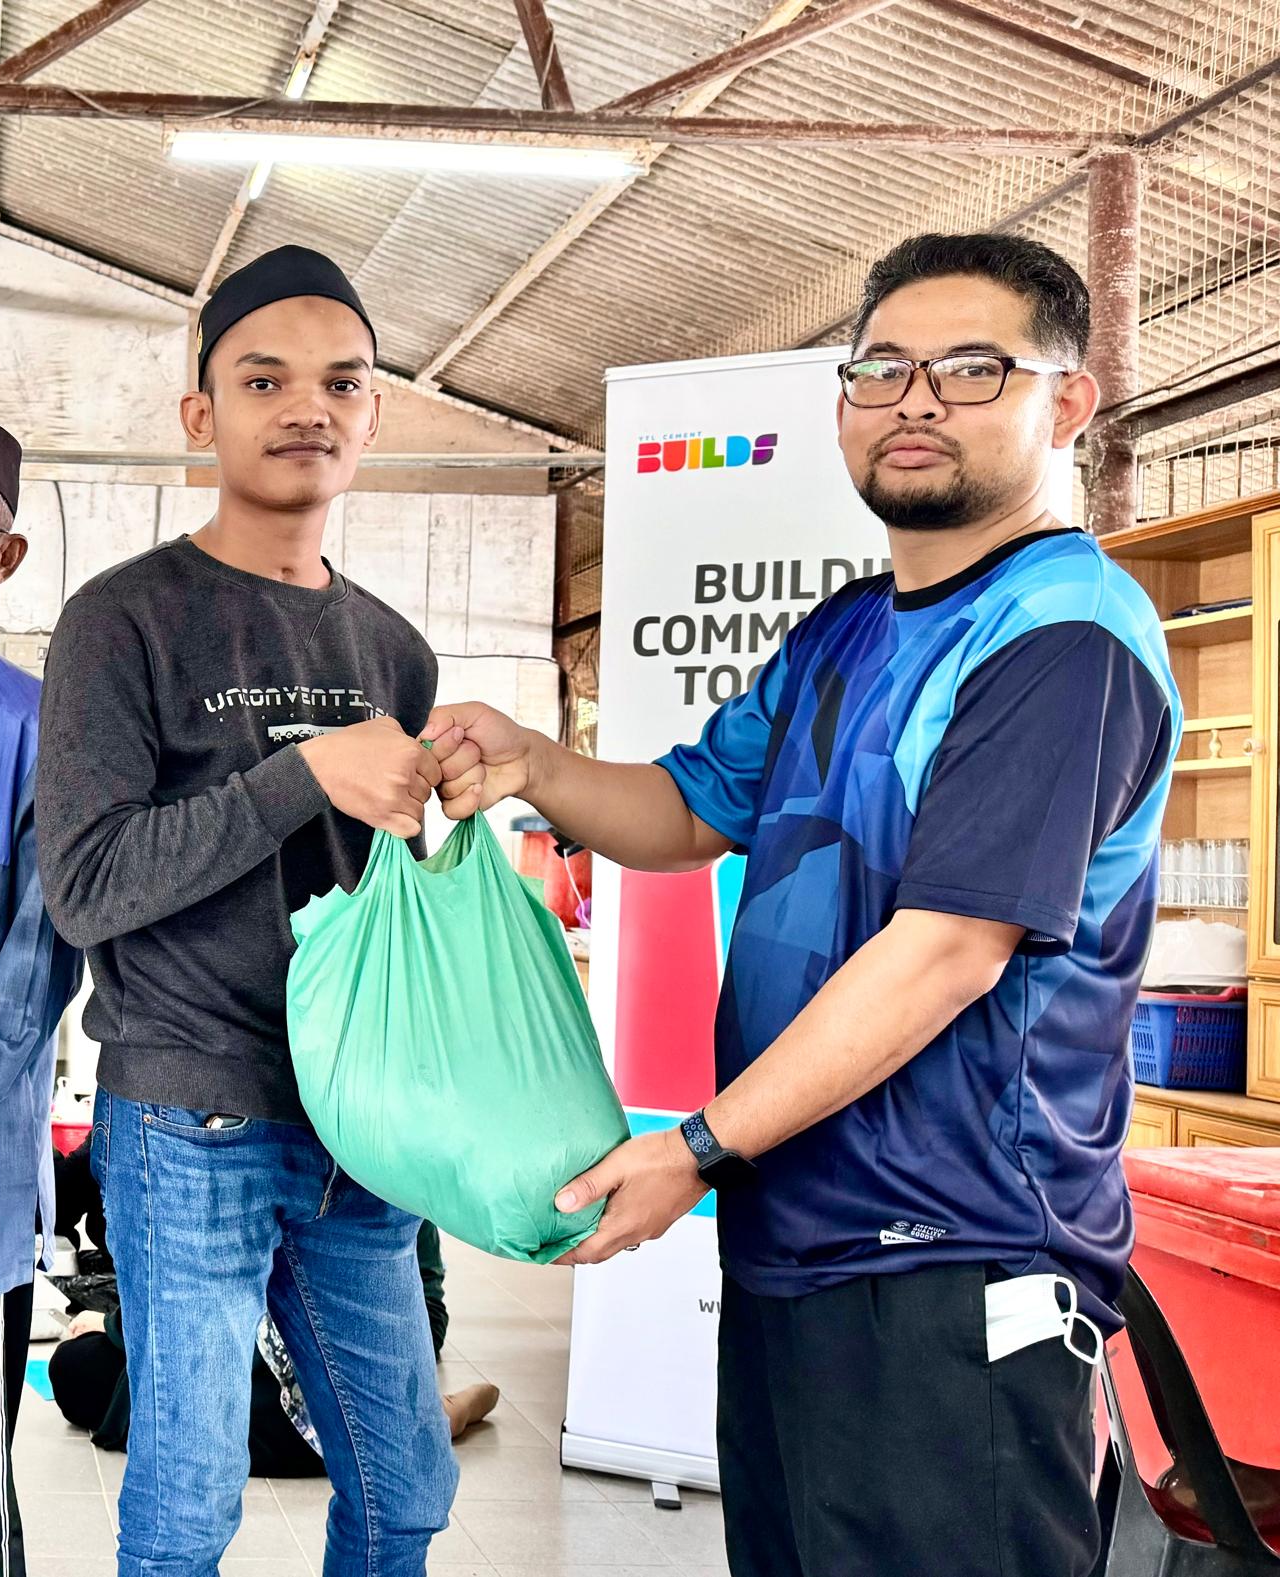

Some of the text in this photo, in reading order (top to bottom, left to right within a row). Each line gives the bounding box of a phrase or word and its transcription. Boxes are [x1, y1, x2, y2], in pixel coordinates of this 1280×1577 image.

[637, 433, 778, 473] BUILDS
[639, 431, 702, 442] YTL CEMENT
[694, 558, 891, 604] BUILD
[633, 611, 809, 657] COMM
[674, 664, 766, 706] TO
[910, 1230, 934, 1242] GOODS
[915, 1223, 947, 1234] PREMIUM
